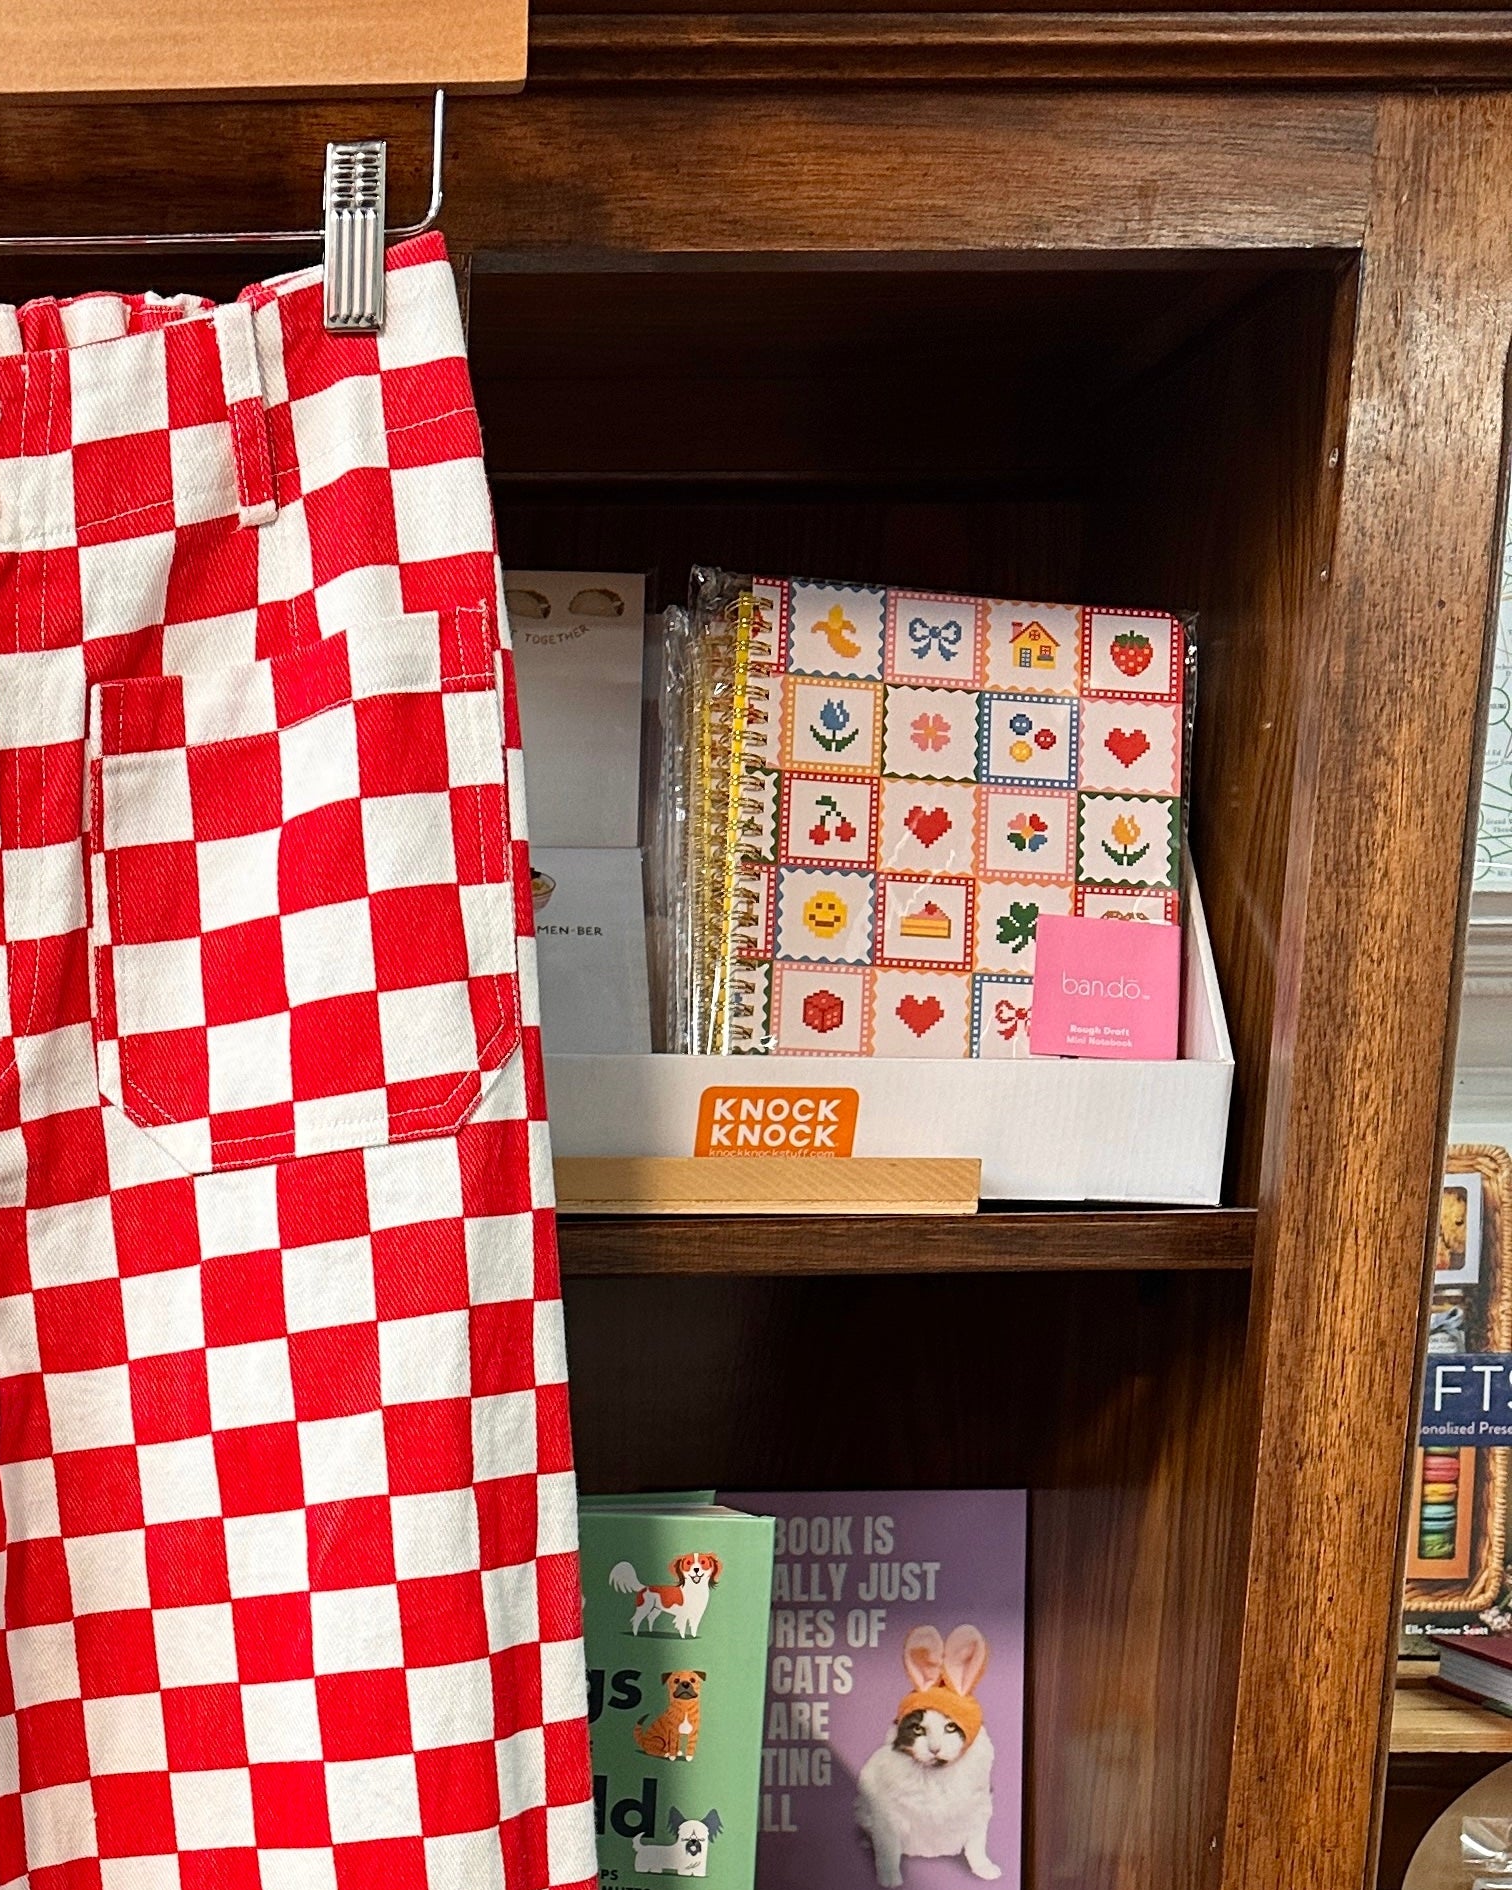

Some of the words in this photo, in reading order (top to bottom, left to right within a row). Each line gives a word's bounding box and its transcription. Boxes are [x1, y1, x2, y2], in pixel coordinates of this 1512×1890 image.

[525, 624, 589, 645] TOGETHER
[1066, 1035, 1086, 1045] Mini
[1088, 1036, 1132, 1048] Notebook
[1069, 1024, 1101, 1036] Rough
[1103, 1026, 1130, 1037] Draft
[713, 1098, 842, 1122] KNOCK
[710, 1123, 838, 1148] KNOCK
[1434, 1365, 1512, 1412] FT
[1421, 1421, 1475, 1435] onalized
[774, 1515, 853, 1556] BOOK
[863, 1515, 895, 1555] IS
[858, 1561, 941, 1601] JUST
[846, 1608, 887, 1648] OF
[771, 1655, 854, 1695] CATS
[767, 1701, 830, 1741] ARE
